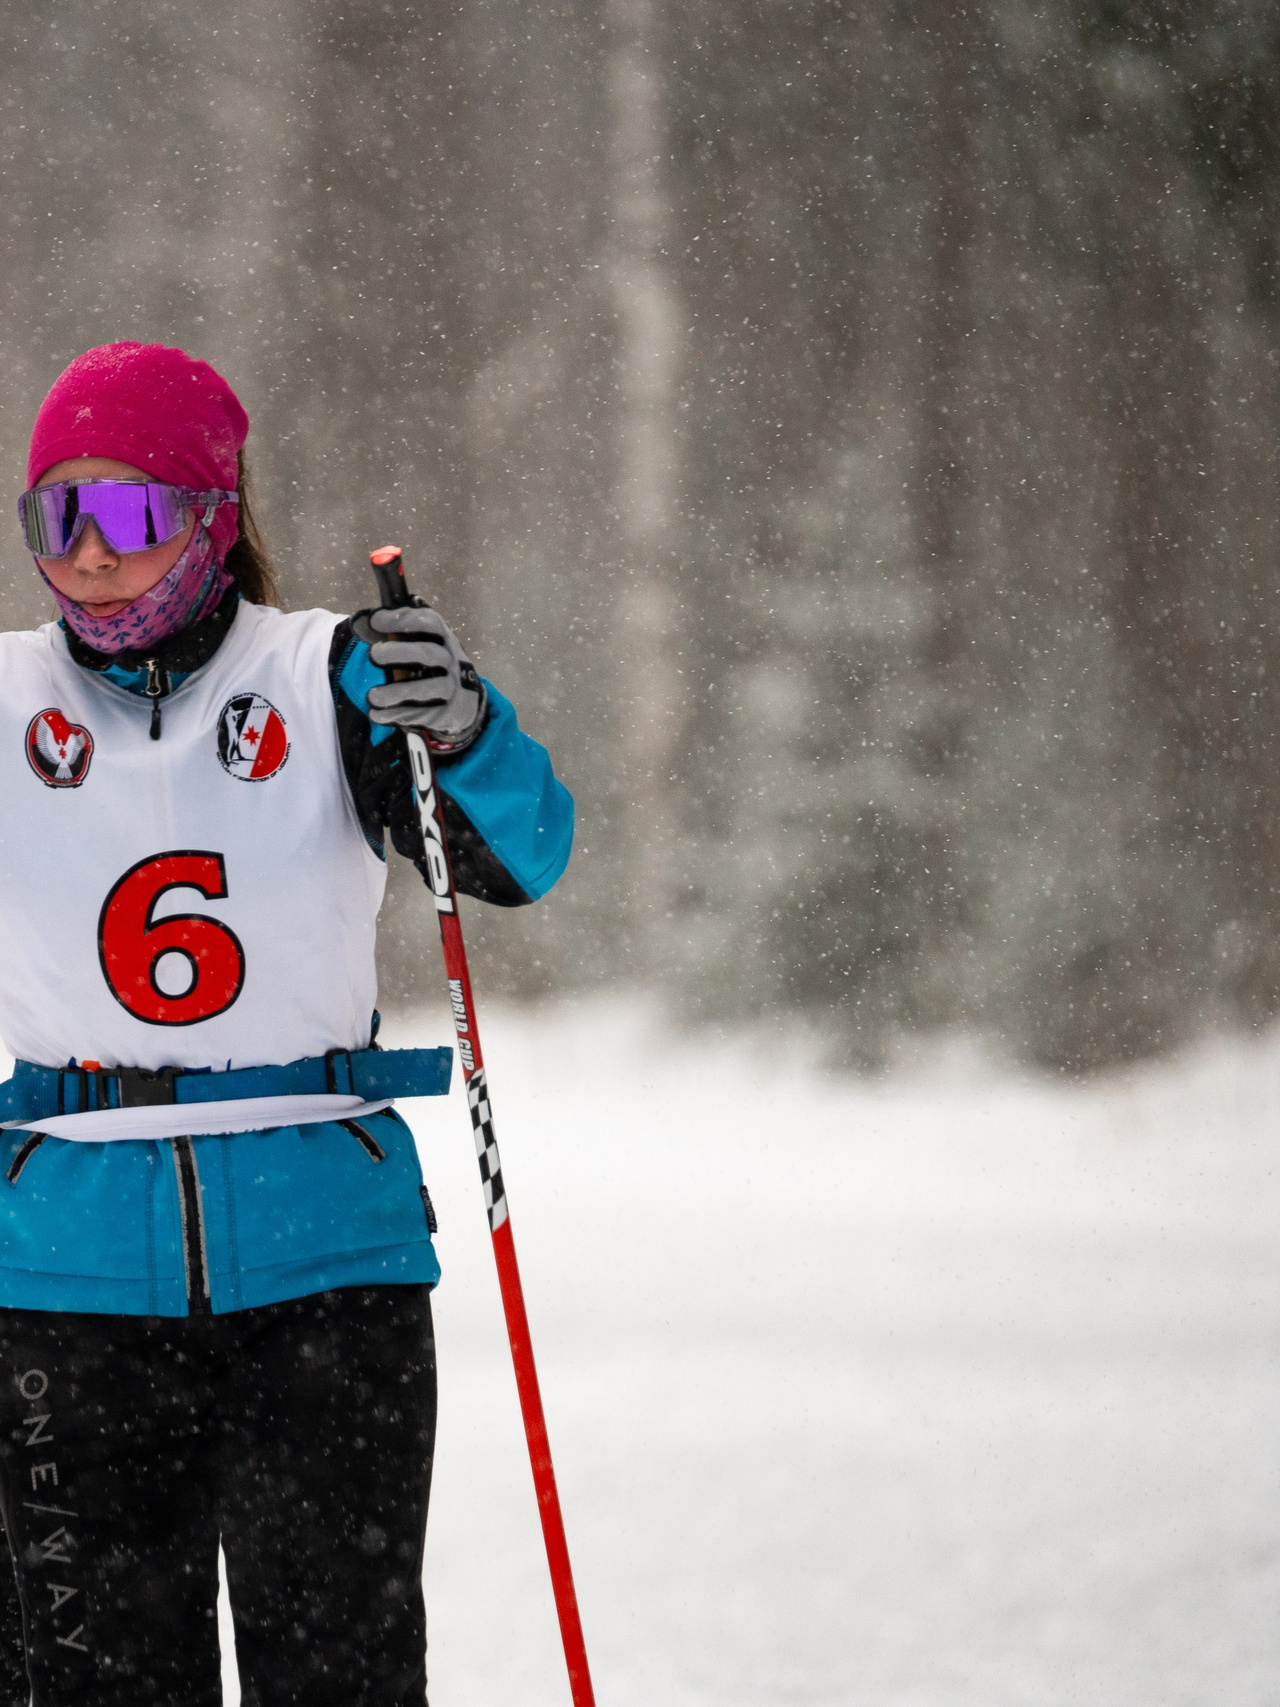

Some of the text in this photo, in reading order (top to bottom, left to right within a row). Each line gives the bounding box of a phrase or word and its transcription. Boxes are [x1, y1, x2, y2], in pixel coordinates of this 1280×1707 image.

[96, 849, 246, 1027] 6
[447, 978, 476, 1072] WORLD CUP
